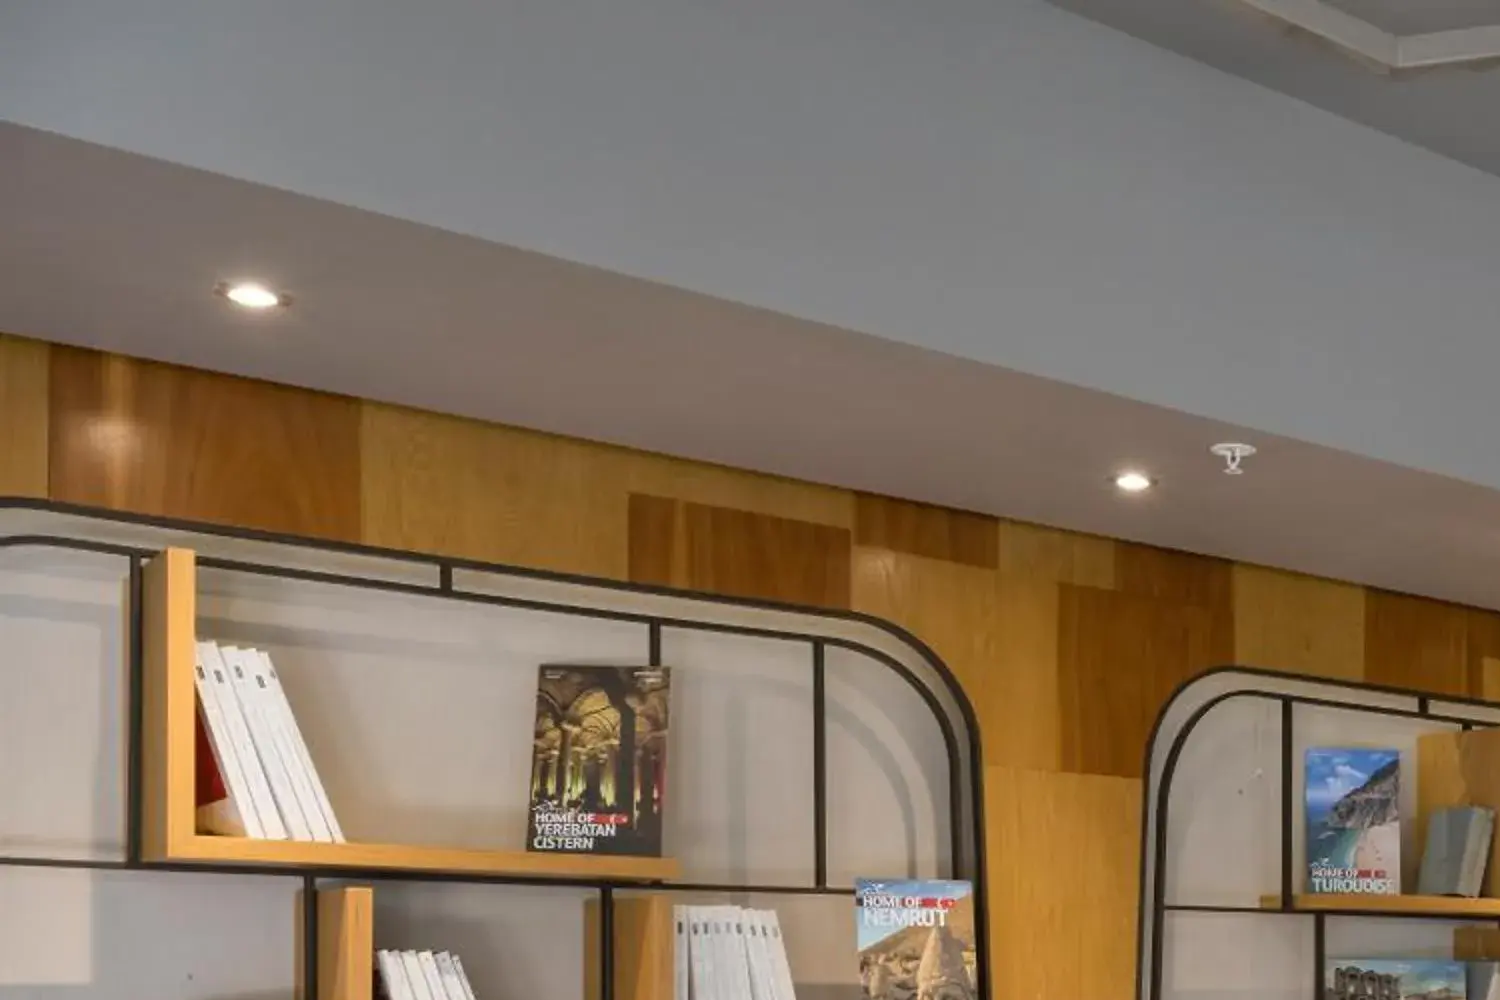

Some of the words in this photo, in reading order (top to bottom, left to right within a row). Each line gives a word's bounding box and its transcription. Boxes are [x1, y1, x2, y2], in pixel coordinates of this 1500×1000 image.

[577, 812, 596, 823] OF
[535, 823, 616, 837] YEREBATAN
[533, 836, 595, 850] CISTERN
[863, 908, 948, 928] NEMRUT
